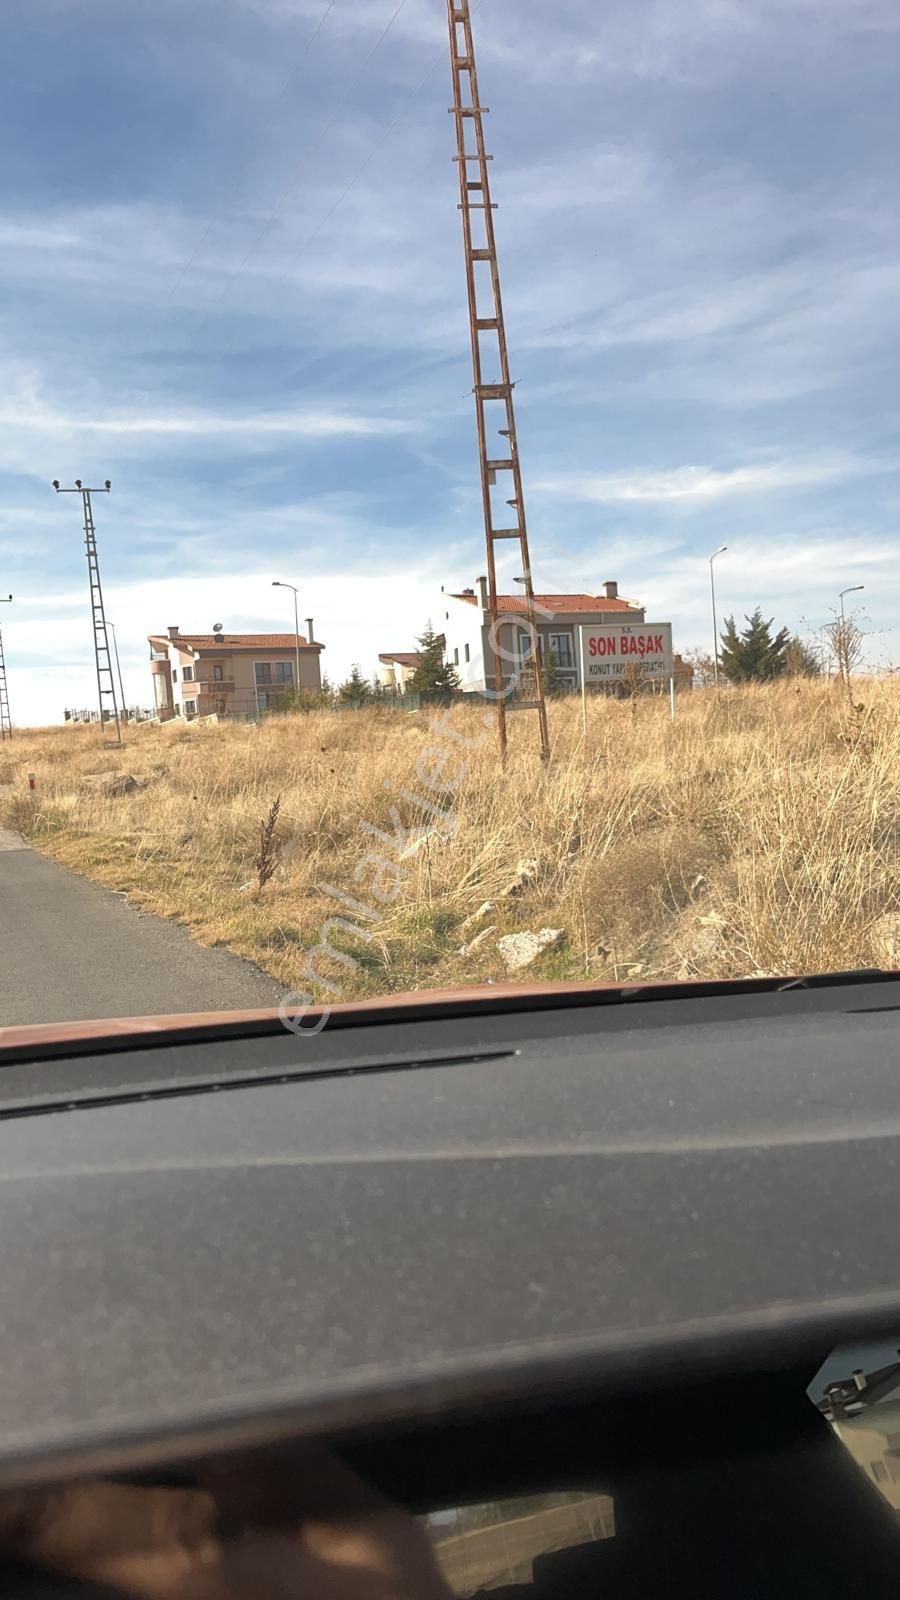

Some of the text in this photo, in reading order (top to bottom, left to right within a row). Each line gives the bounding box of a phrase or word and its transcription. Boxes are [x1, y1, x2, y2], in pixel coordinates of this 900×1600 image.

[589, 635, 664, 659] SON BAŞAK
[589, 664, 610, 675] KONUT
